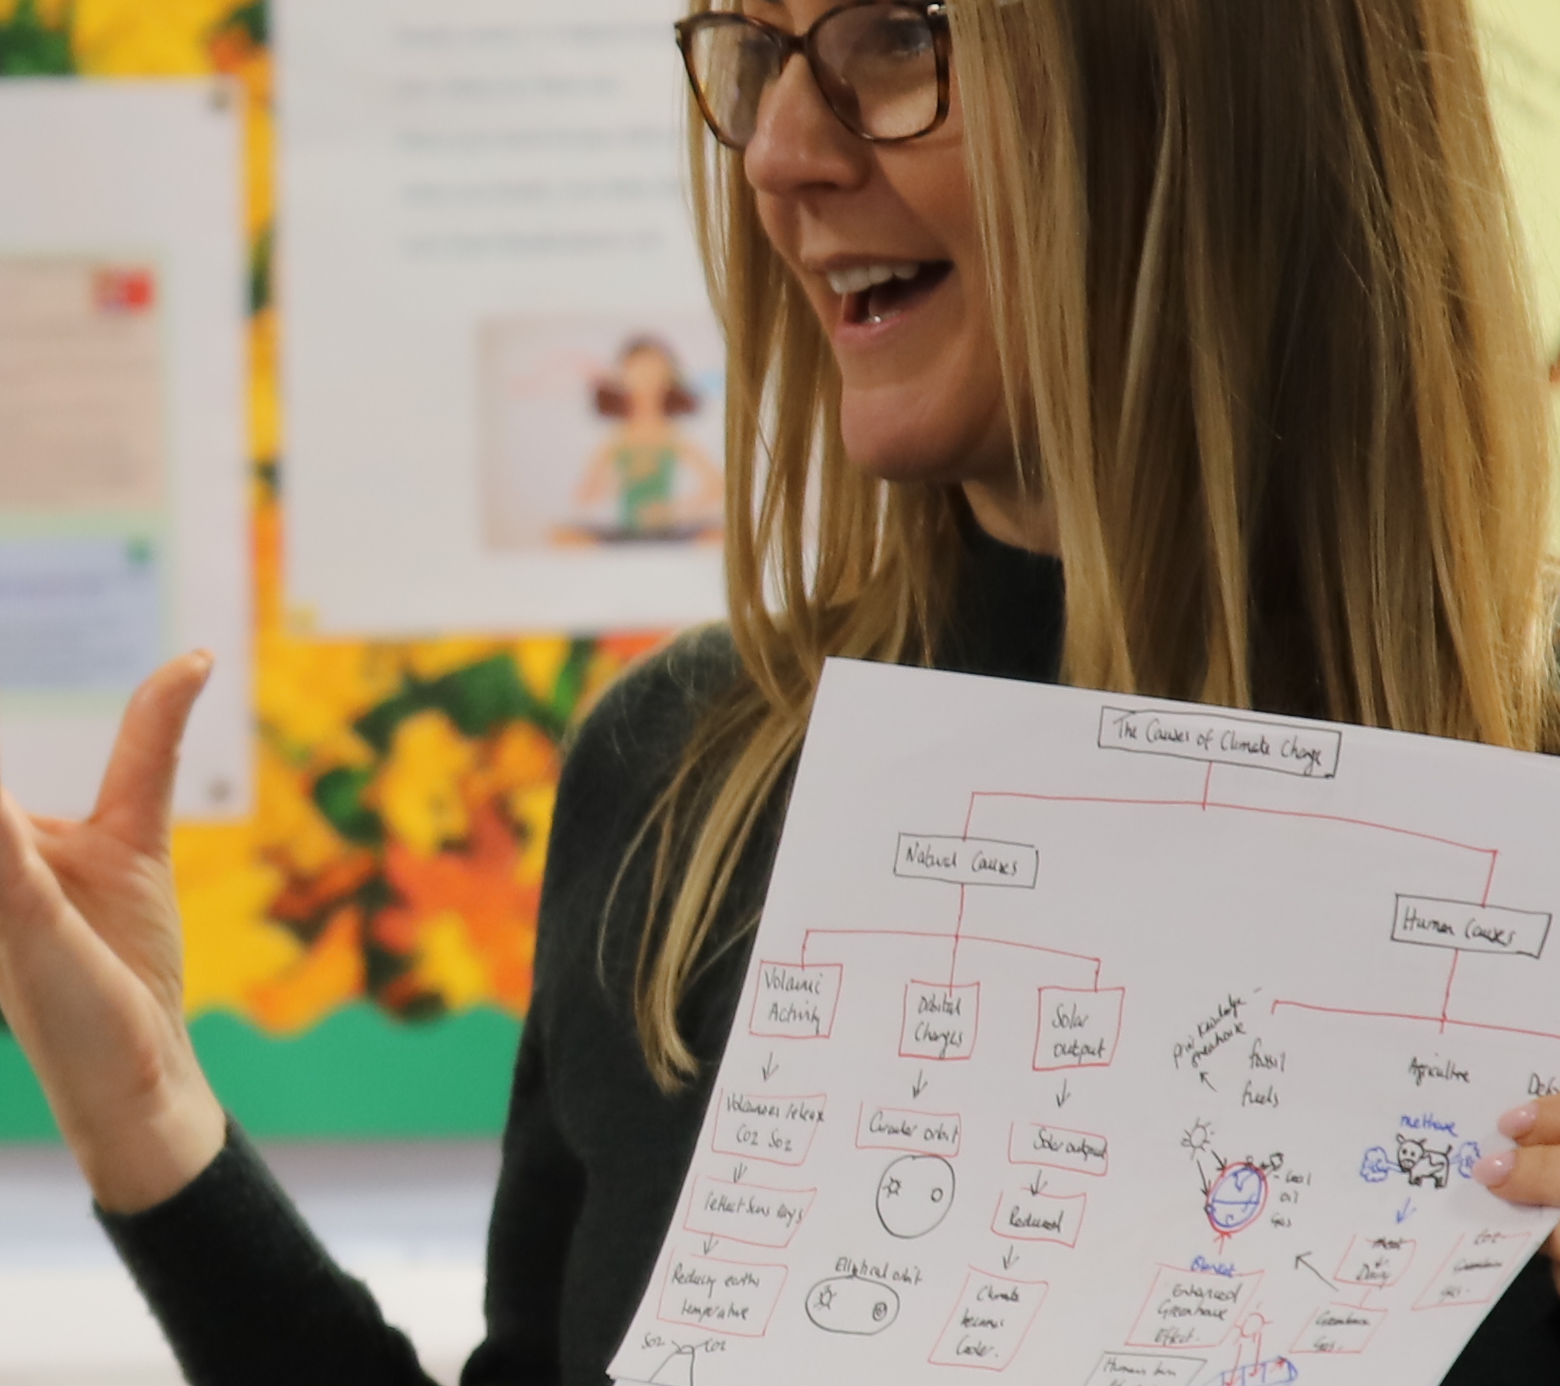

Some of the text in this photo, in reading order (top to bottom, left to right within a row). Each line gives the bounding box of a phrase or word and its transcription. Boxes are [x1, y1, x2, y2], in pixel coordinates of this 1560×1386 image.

[1113, 713, 1322, 776] The Causes of Climate Change
[906, 842, 1018, 876] Natural Causes
[1403, 906, 1517, 948] Human Causes
[768, 999, 821, 1035] Activity
[1051, 1003, 1091, 1030] Solar
[1400, 1113, 1458, 1137] methane
